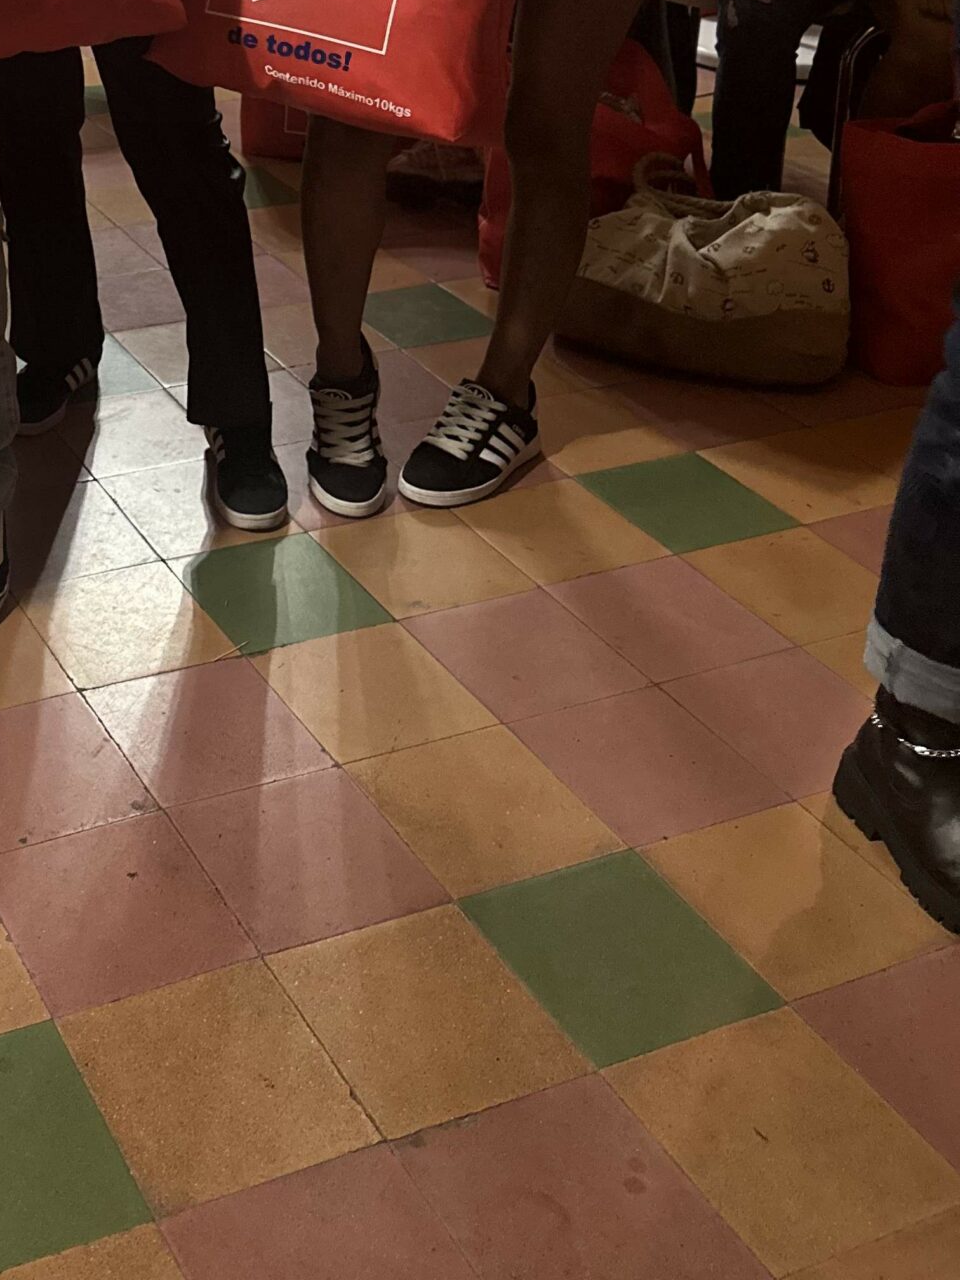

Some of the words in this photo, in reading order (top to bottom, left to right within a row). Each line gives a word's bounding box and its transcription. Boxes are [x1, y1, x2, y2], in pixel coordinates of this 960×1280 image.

[228, 26, 258, 49] de
[266, 34, 353, 72] todos!
[264, 64, 326, 91] Contenido
